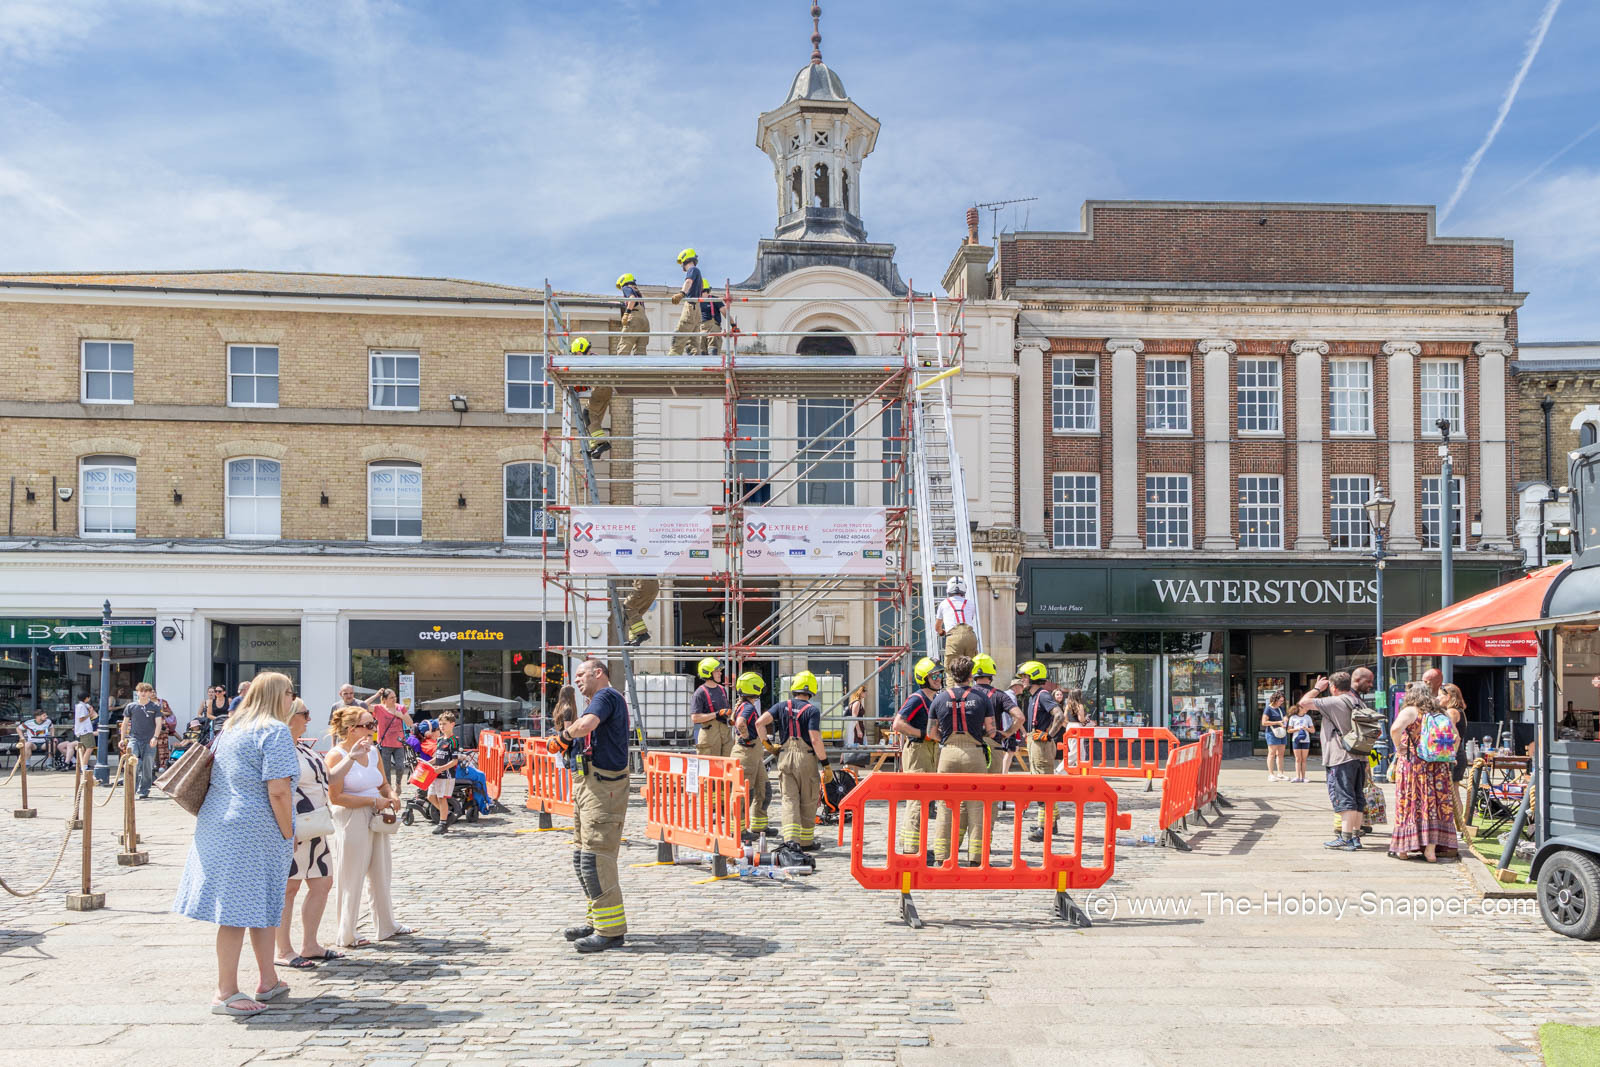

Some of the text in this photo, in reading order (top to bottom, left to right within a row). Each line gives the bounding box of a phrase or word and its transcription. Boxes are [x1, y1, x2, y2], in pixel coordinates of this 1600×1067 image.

[1152, 579, 1383, 604] WATERSTONES
[1068, 604, 1084, 612] Place
[250, 640, 277, 648] govox
